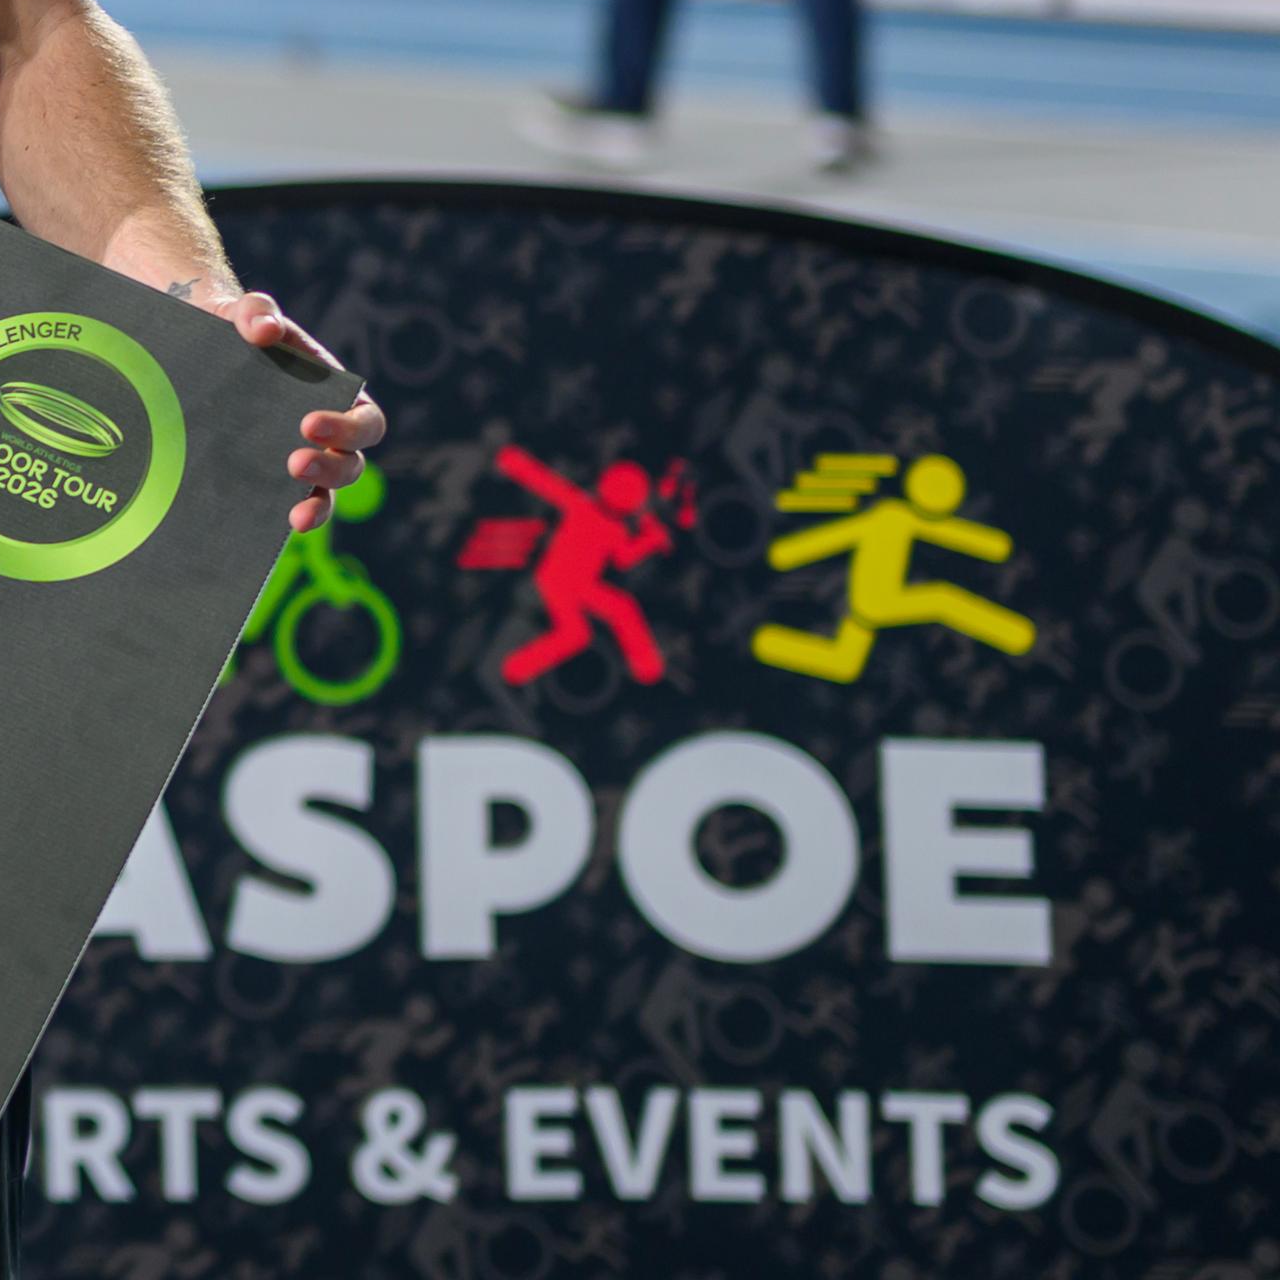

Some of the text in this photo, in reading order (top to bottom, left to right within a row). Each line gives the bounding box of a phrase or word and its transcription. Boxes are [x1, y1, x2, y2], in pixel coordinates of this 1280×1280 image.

[50, 468, 117, 512] TOUR
[92, 728, 1054, 969] ASPOE
[40, 1084, 1061, 1212] RTS & EVENTS
